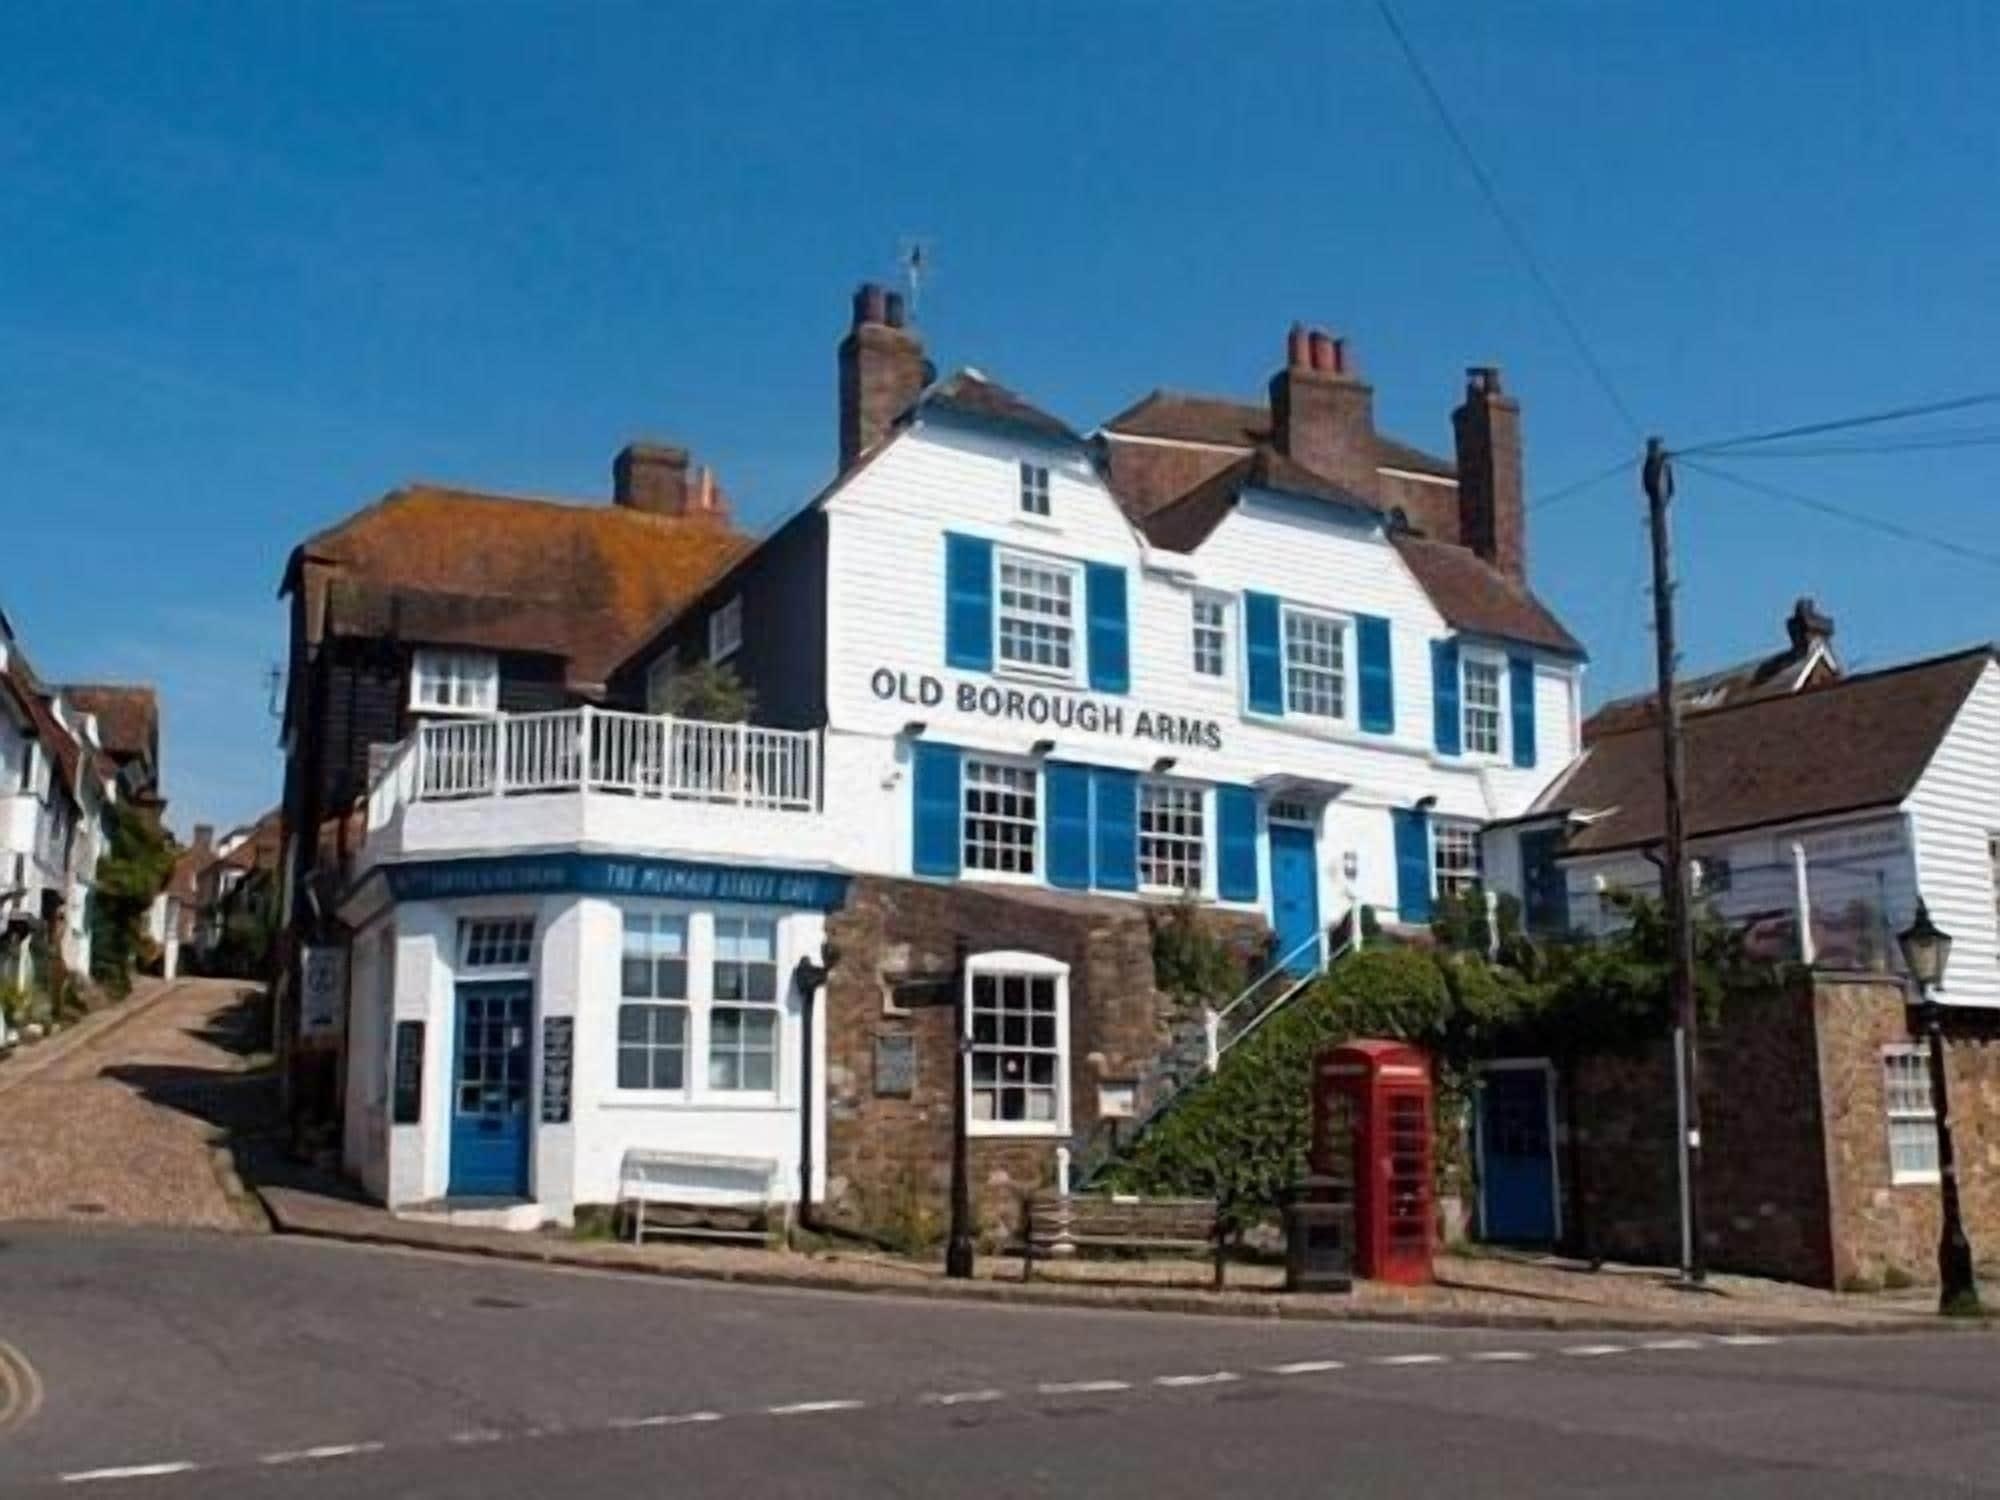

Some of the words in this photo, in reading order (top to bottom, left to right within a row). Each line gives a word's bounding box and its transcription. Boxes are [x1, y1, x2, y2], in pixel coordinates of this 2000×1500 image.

[872, 668, 943, 707] OLD
[956, 683, 1122, 735] BOROUGH
[1134, 709, 1222, 750] ARMS
